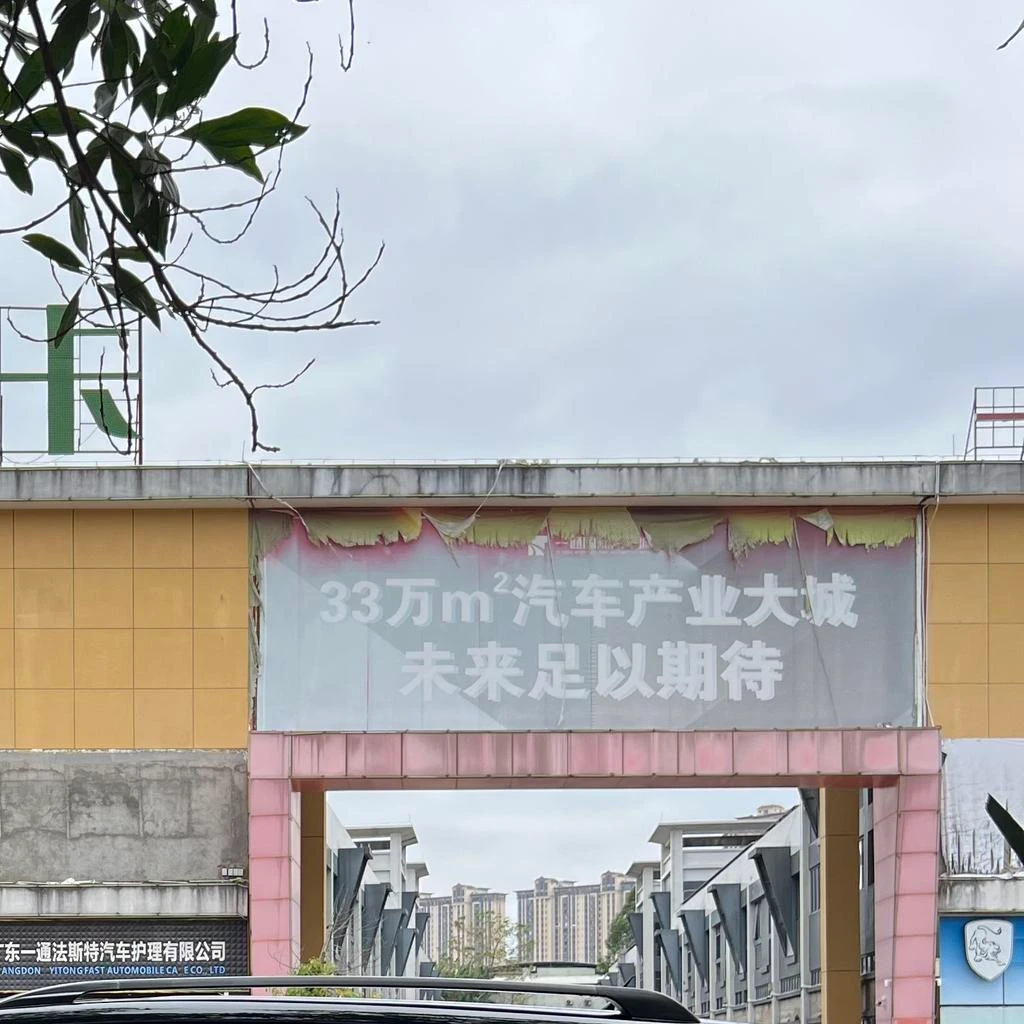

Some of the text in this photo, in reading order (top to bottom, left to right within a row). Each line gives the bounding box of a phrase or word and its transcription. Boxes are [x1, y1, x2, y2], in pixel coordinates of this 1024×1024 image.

[398, 640, 785, 702] 未来足以期待
